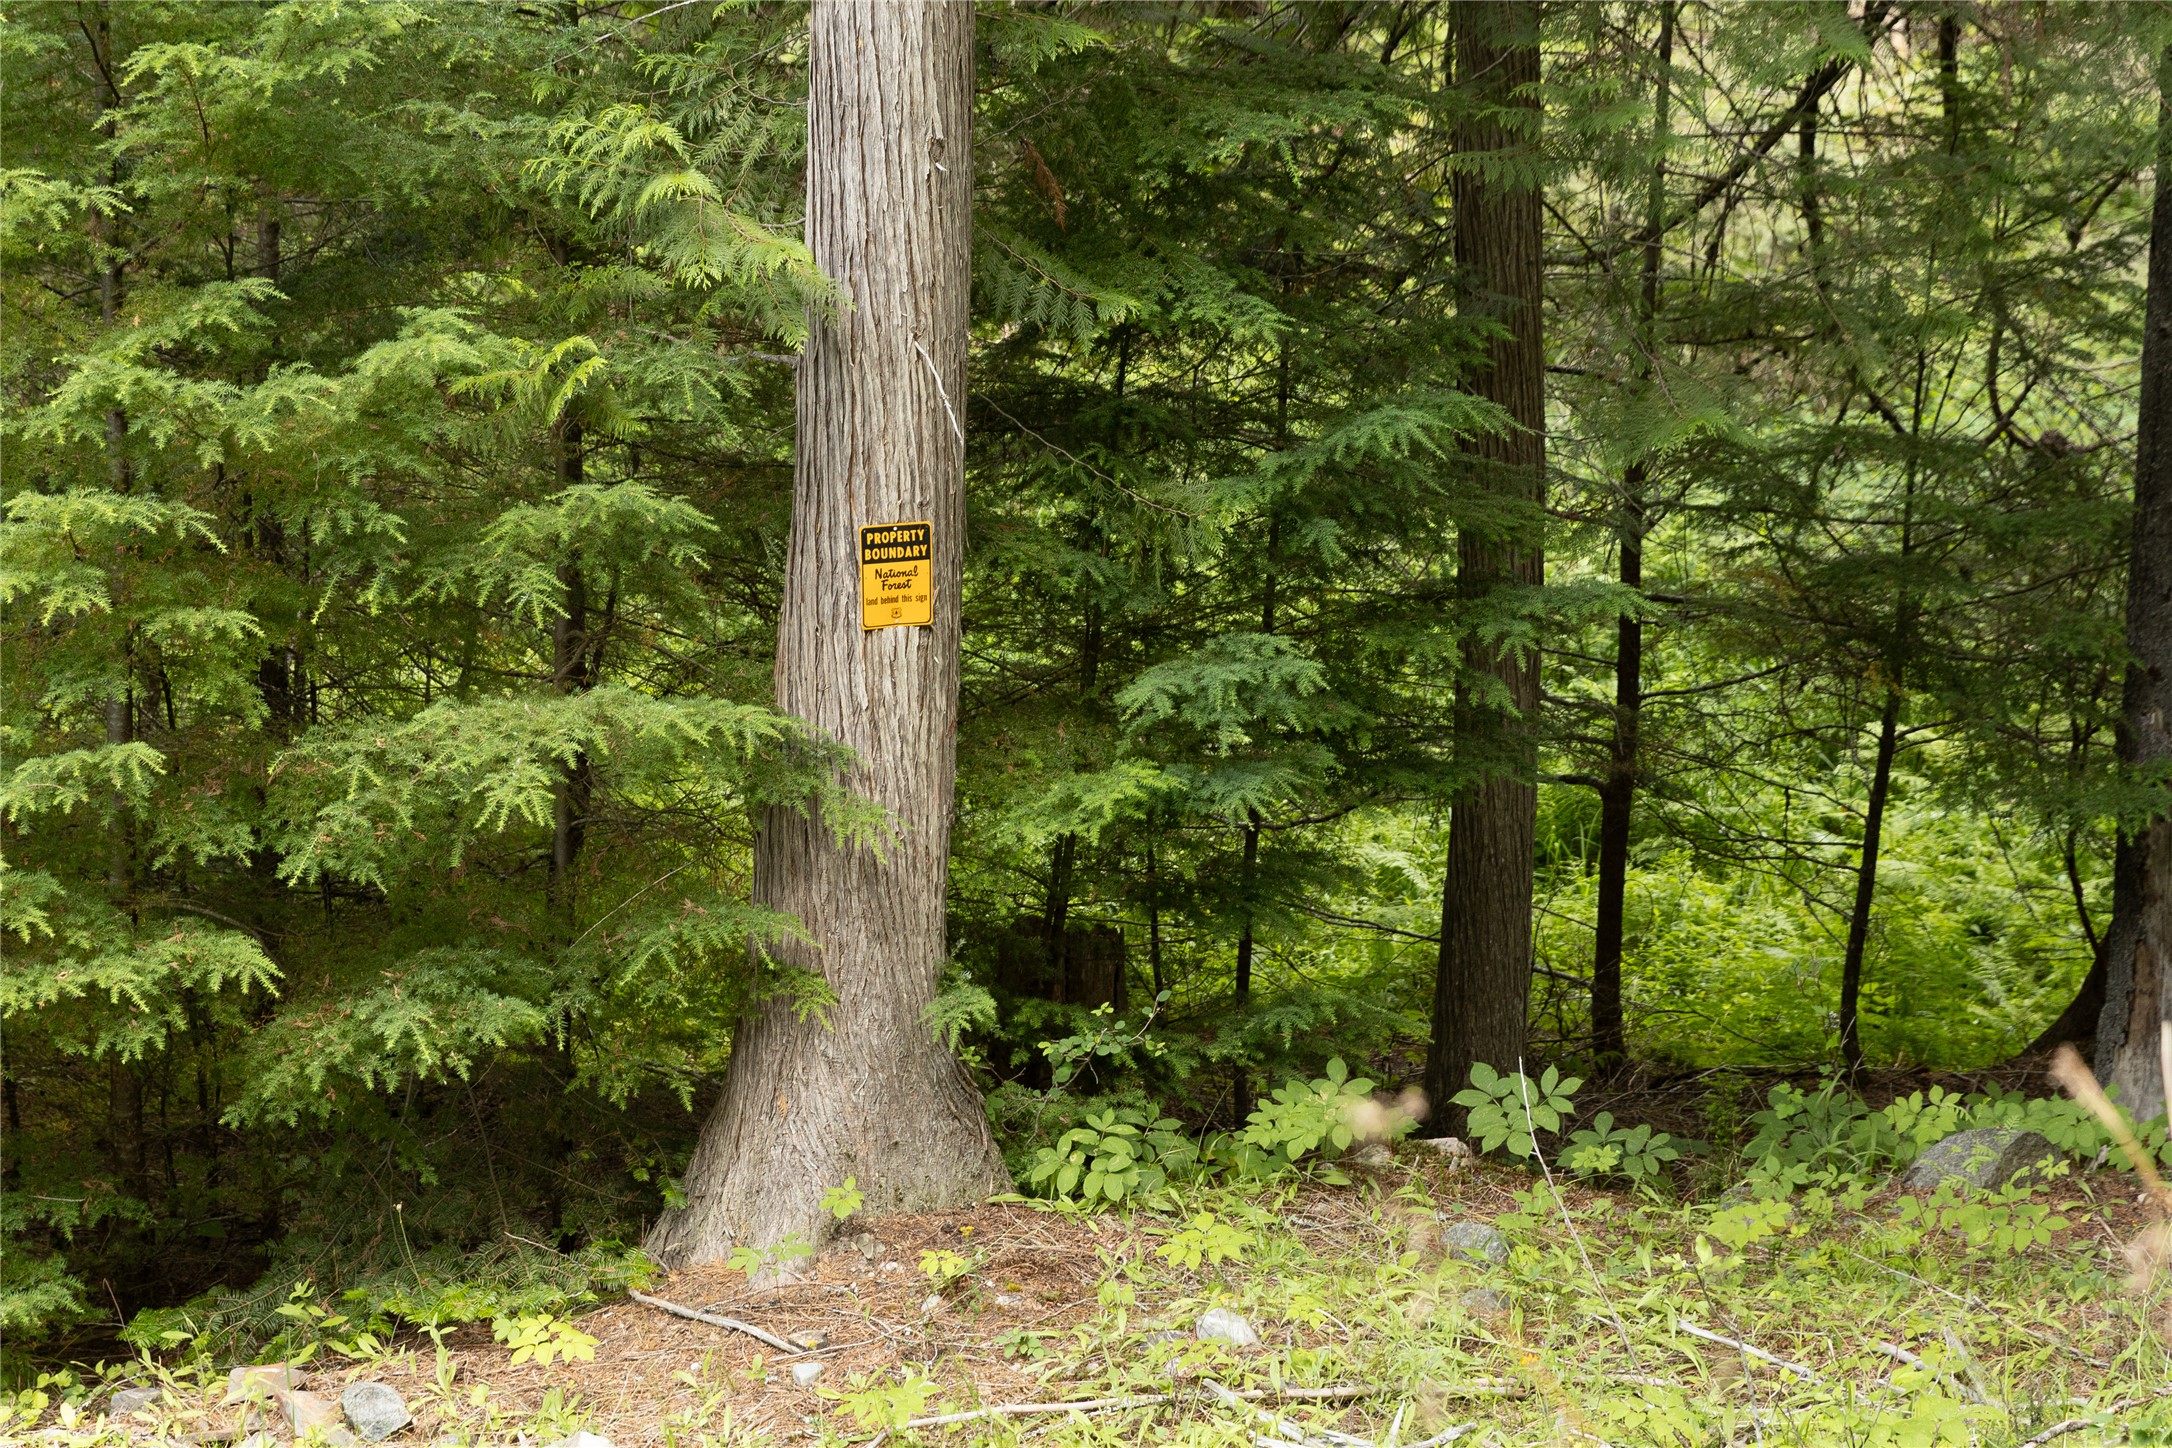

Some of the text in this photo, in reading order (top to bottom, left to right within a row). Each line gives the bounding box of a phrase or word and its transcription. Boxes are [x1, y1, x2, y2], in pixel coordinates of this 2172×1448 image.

[866, 529, 925, 545] PROPERTY
[864, 544, 928, 561] BOUNDARY
[875, 565, 919, 580] National
[881, 579, 912, 591] Forest
[866, 594, 928, 606] land behind this sign
